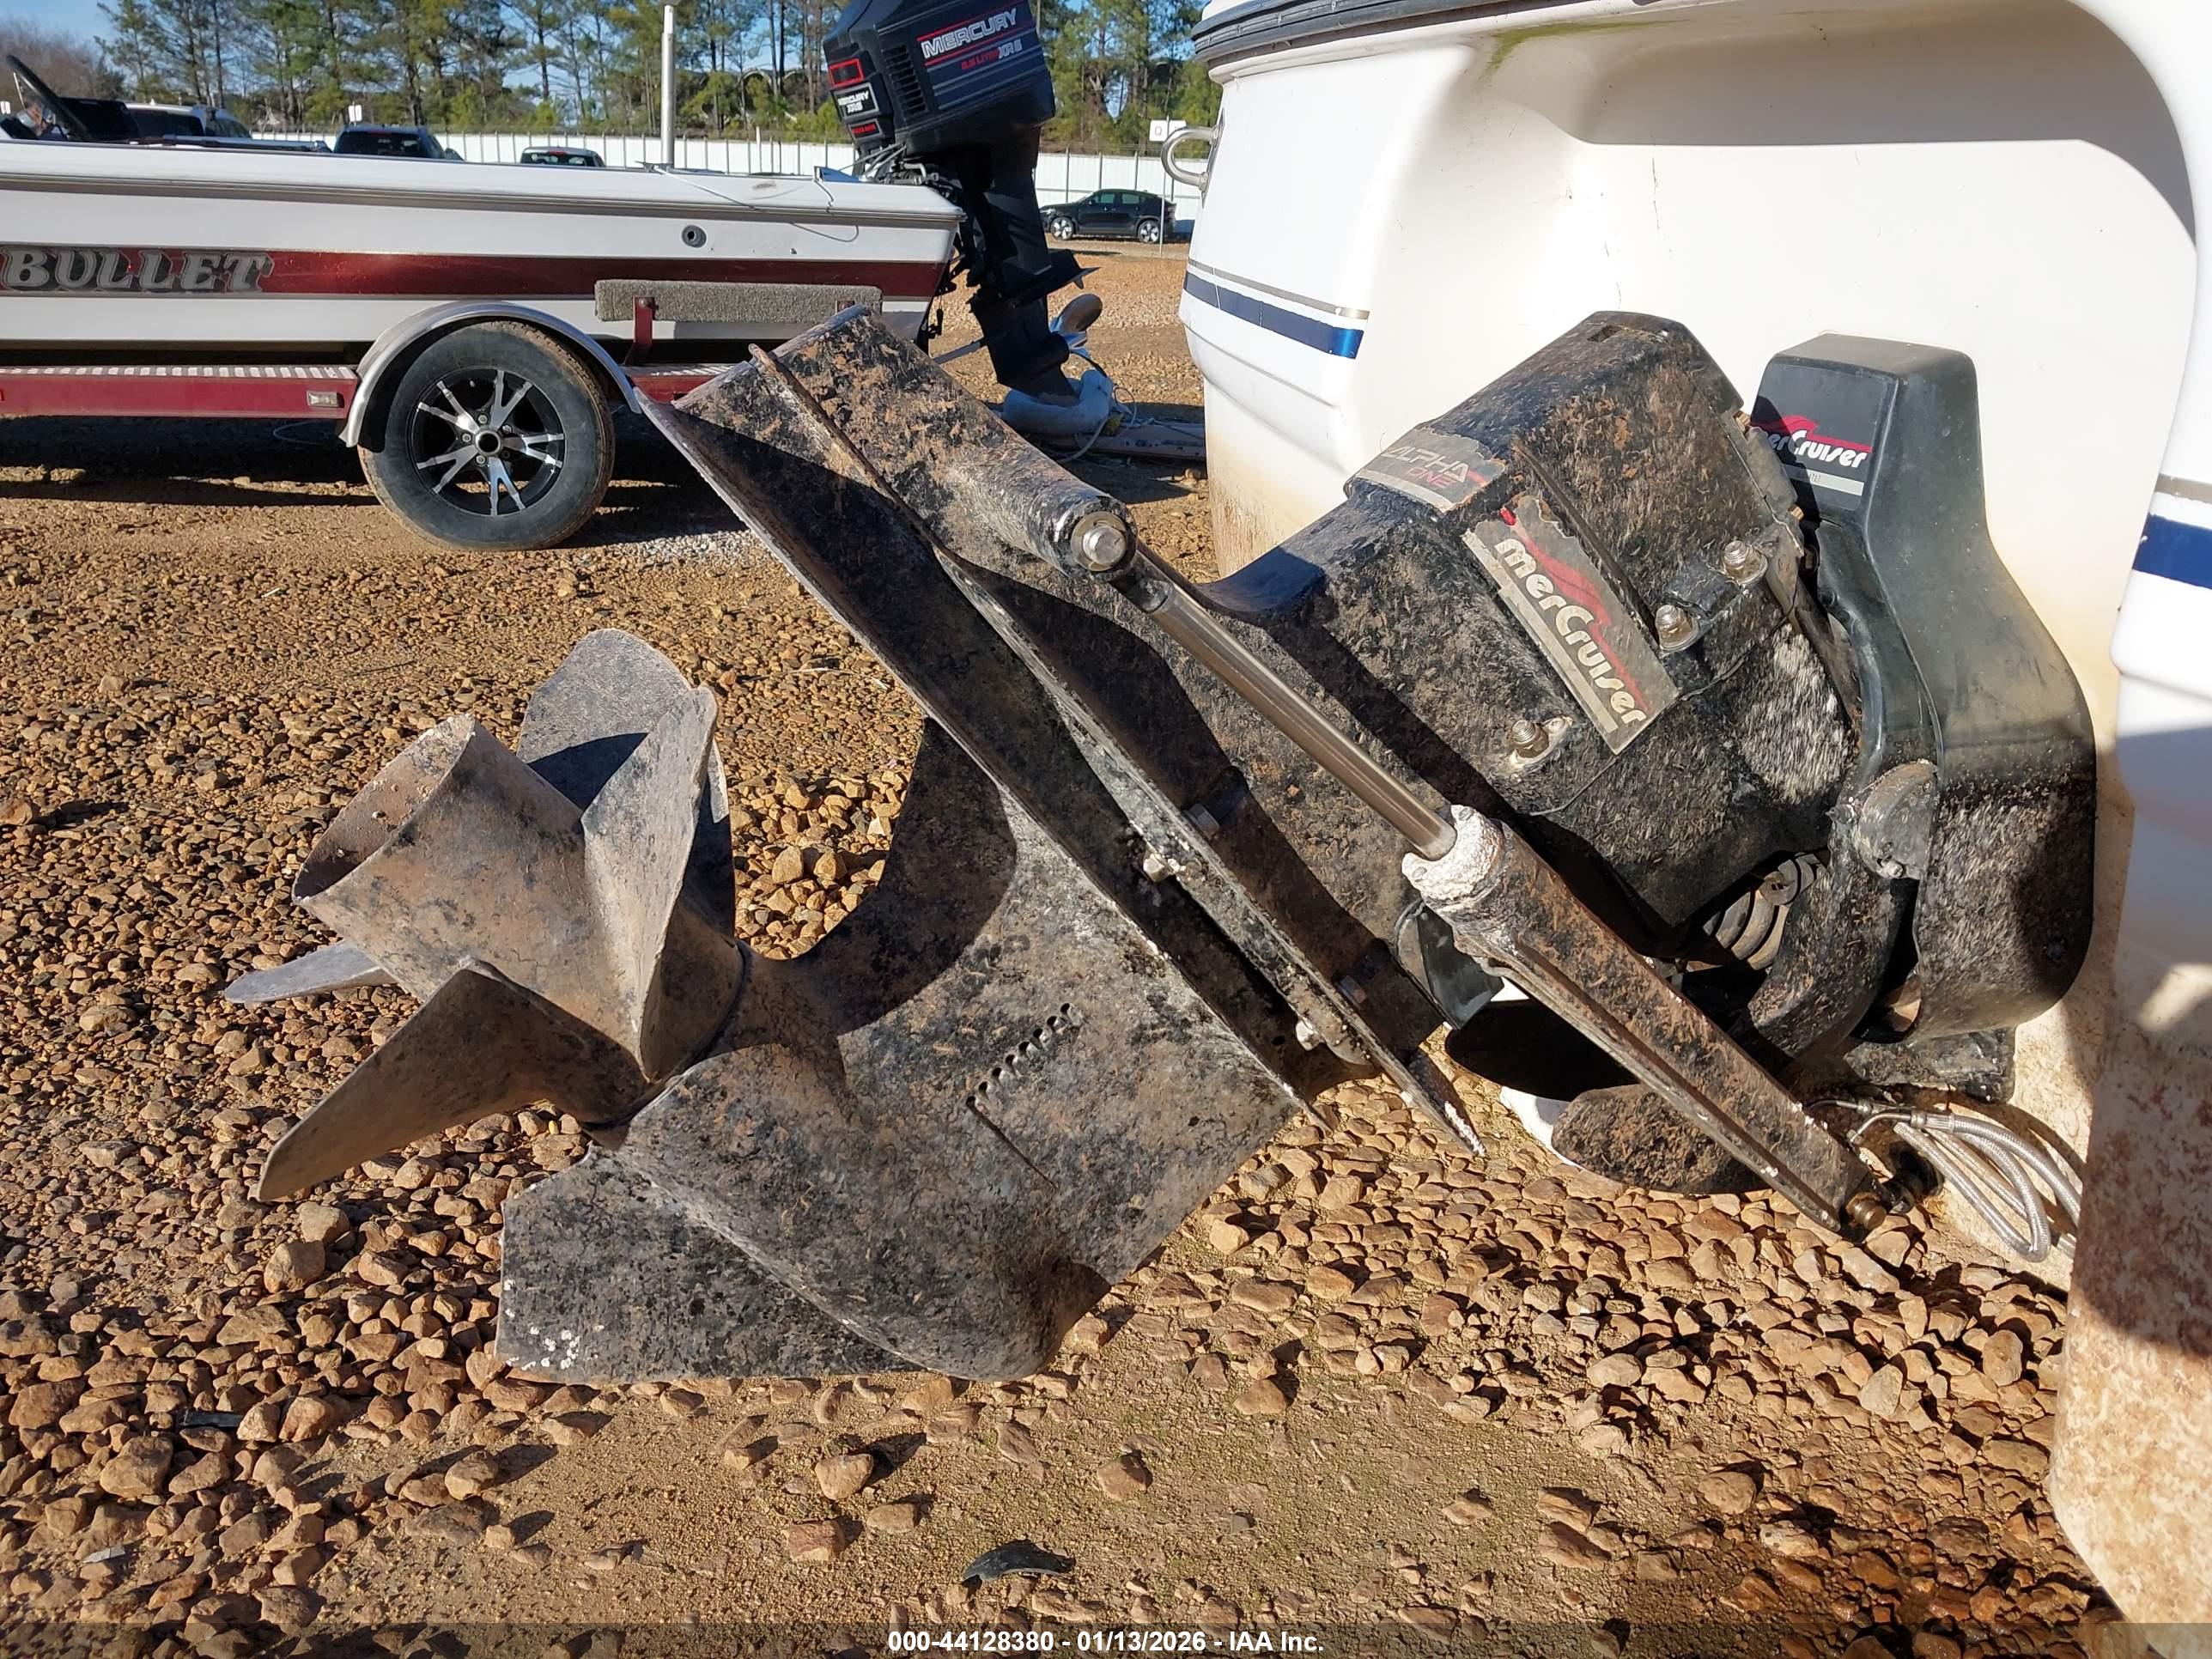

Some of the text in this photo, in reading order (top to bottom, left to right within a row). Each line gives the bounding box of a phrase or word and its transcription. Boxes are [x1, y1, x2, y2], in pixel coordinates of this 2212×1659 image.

[921, 8, 1017, 59] MERCURY
[837, 90, 869, 106] MERCURY
[3, 247, 273, 293] BULLET
[1381, 446, 1469, 483] ALPHA
[1766, 429, 1868, 469] erCruiser
[1407, 466, 1457, 489] ONE
